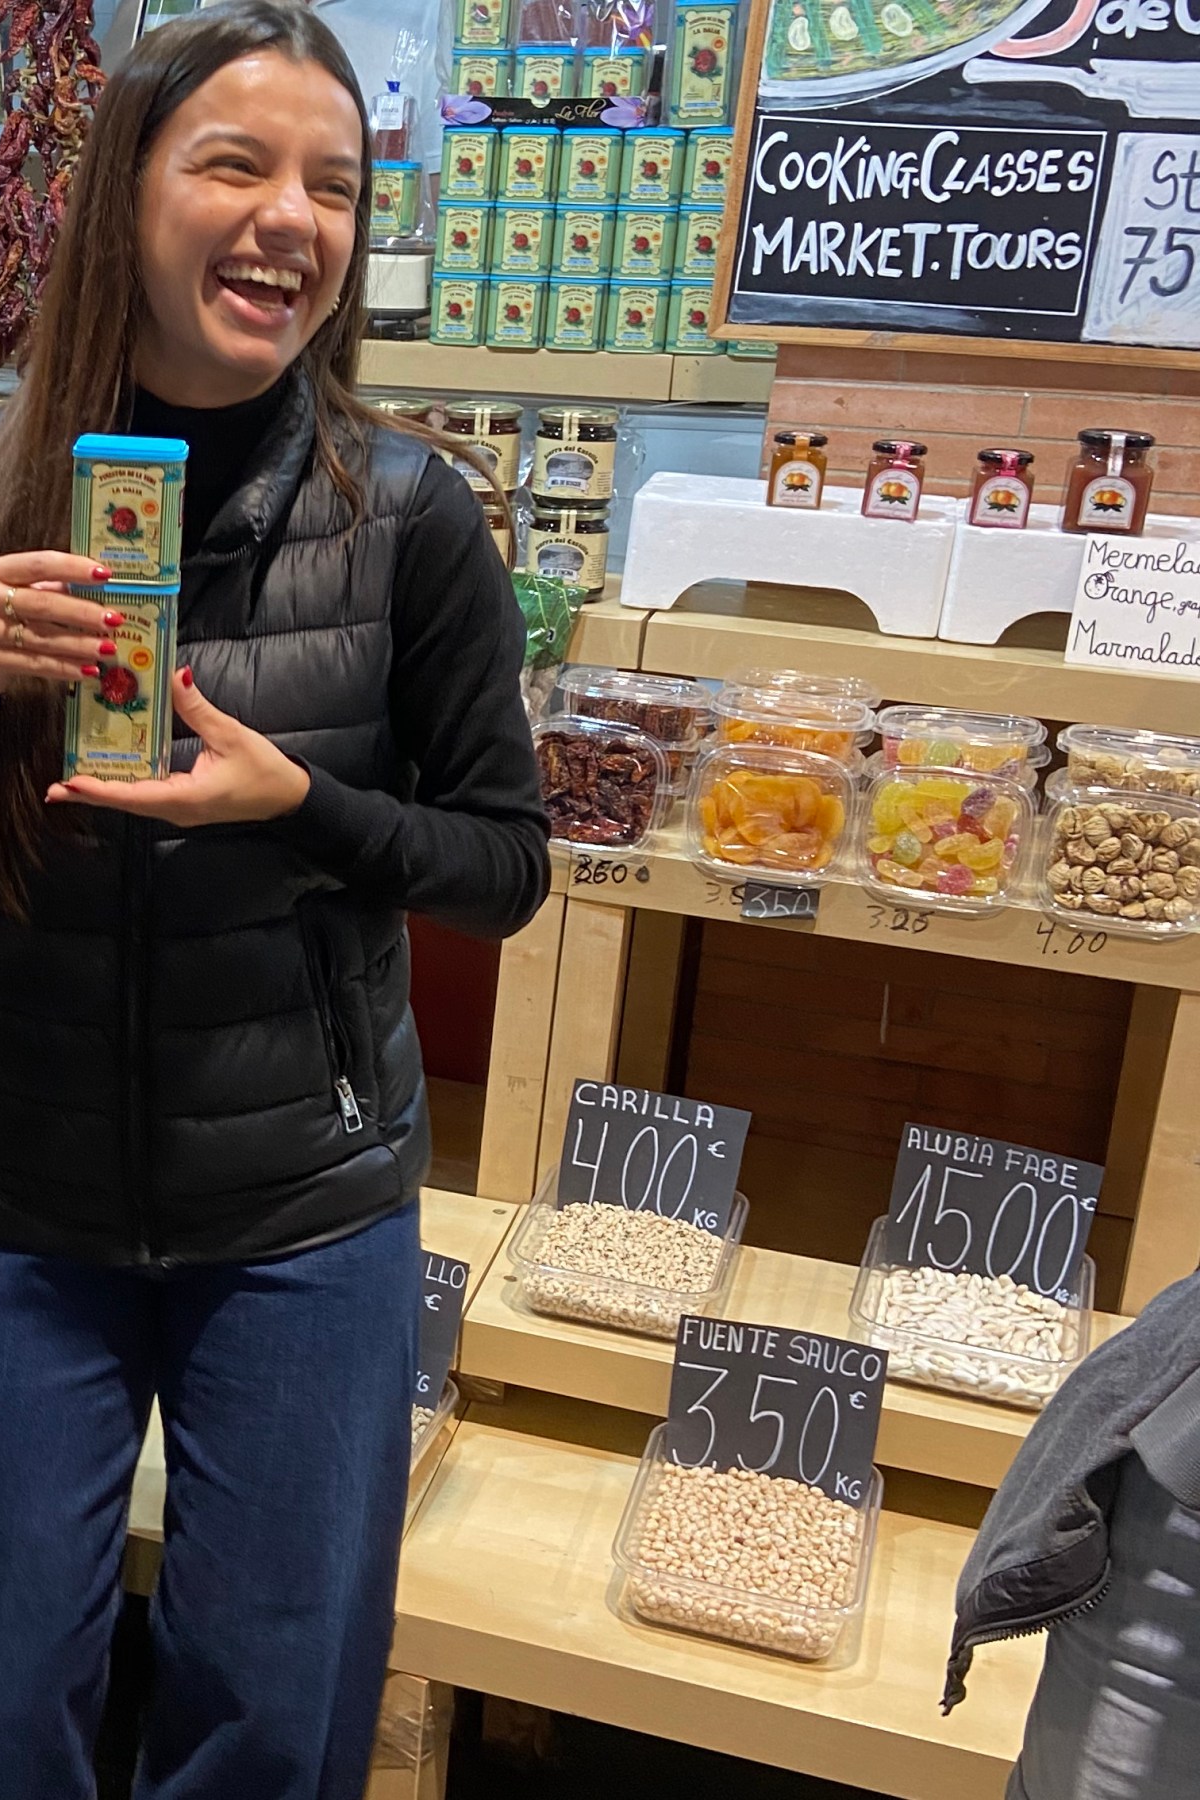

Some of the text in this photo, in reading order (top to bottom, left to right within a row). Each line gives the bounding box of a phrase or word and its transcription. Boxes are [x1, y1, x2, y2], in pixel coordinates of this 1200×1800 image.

[1005, 1149, 1078, 1190] FABE
[692, 1207, 719, 1229] KG
[682, 1318, 882, 1382] FUENTE SAUCO
[835, 1471, 863, 1500] KG
